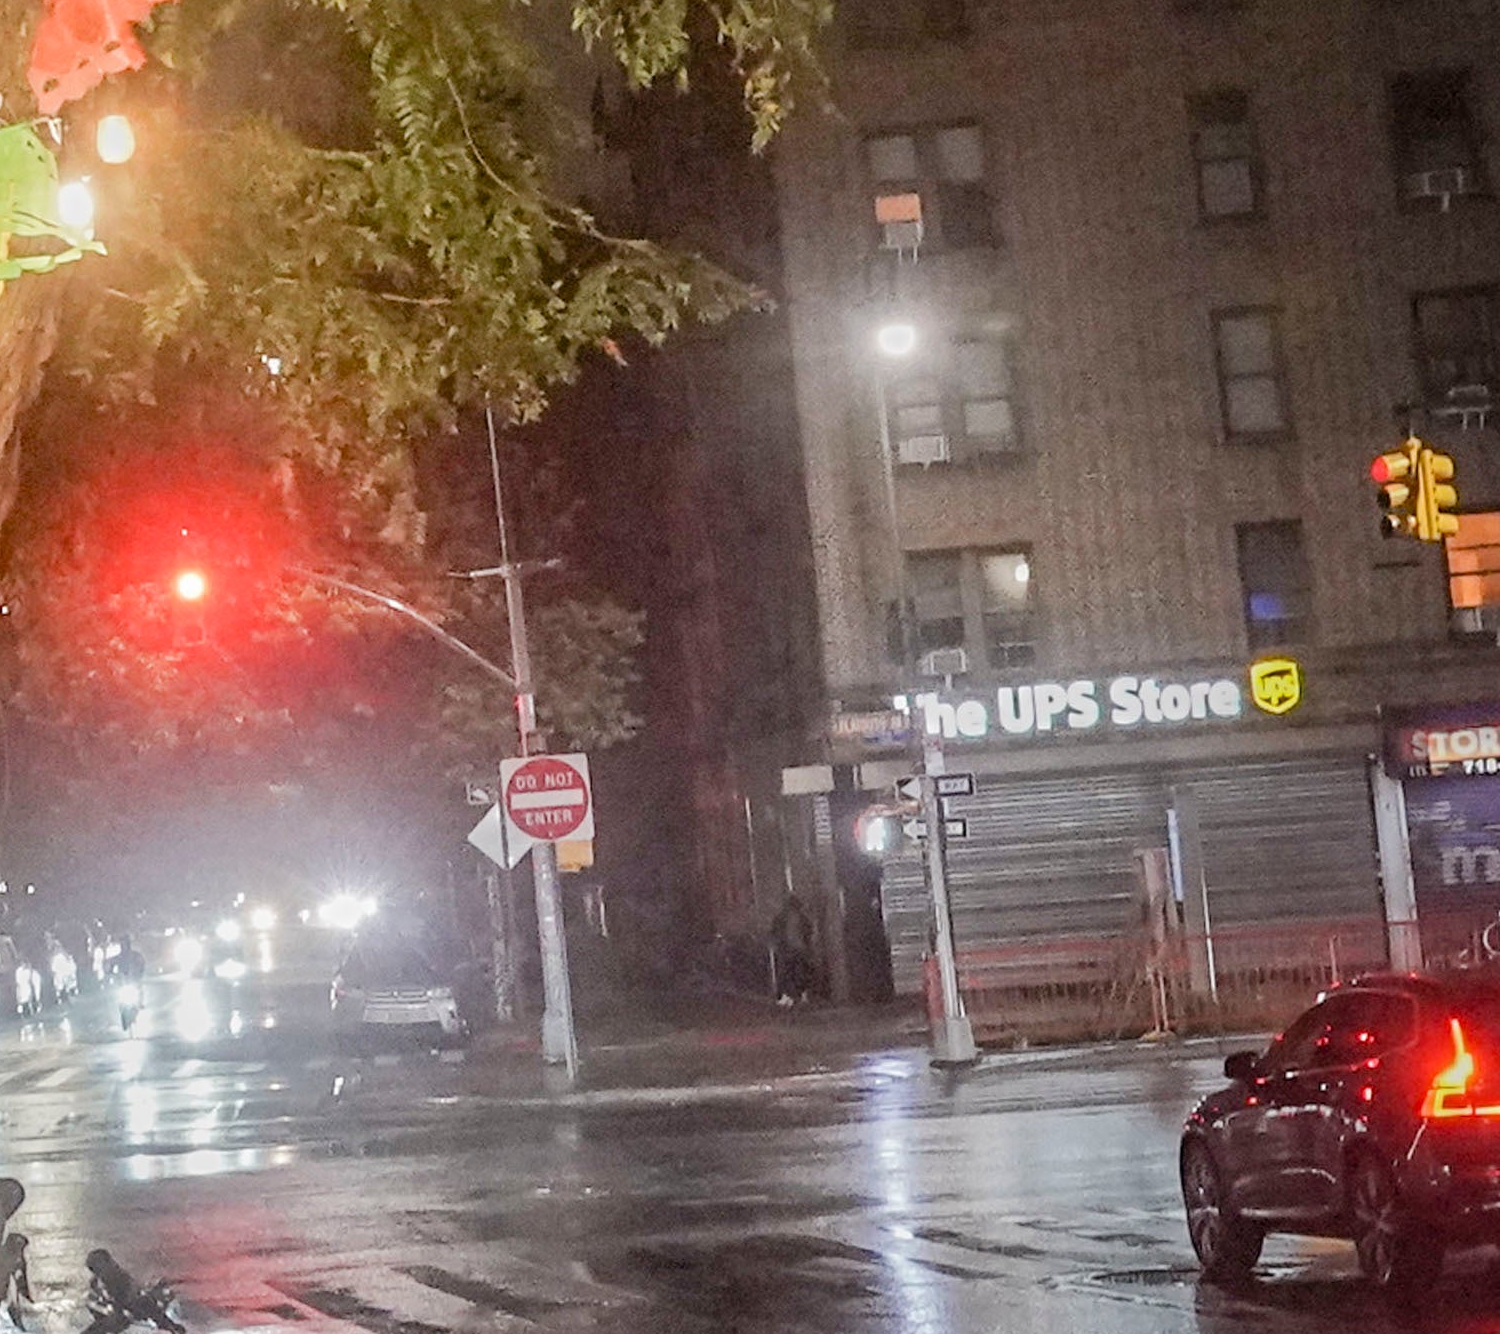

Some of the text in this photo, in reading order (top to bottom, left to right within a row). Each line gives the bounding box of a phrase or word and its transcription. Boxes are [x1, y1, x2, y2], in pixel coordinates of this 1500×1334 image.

[999, 679, 1100, 735] UPS
[1108, 675, 1242, 726] Store
[515, 771, 574, 791] DO NOT
[524, 808, 574, 827] ENTER
